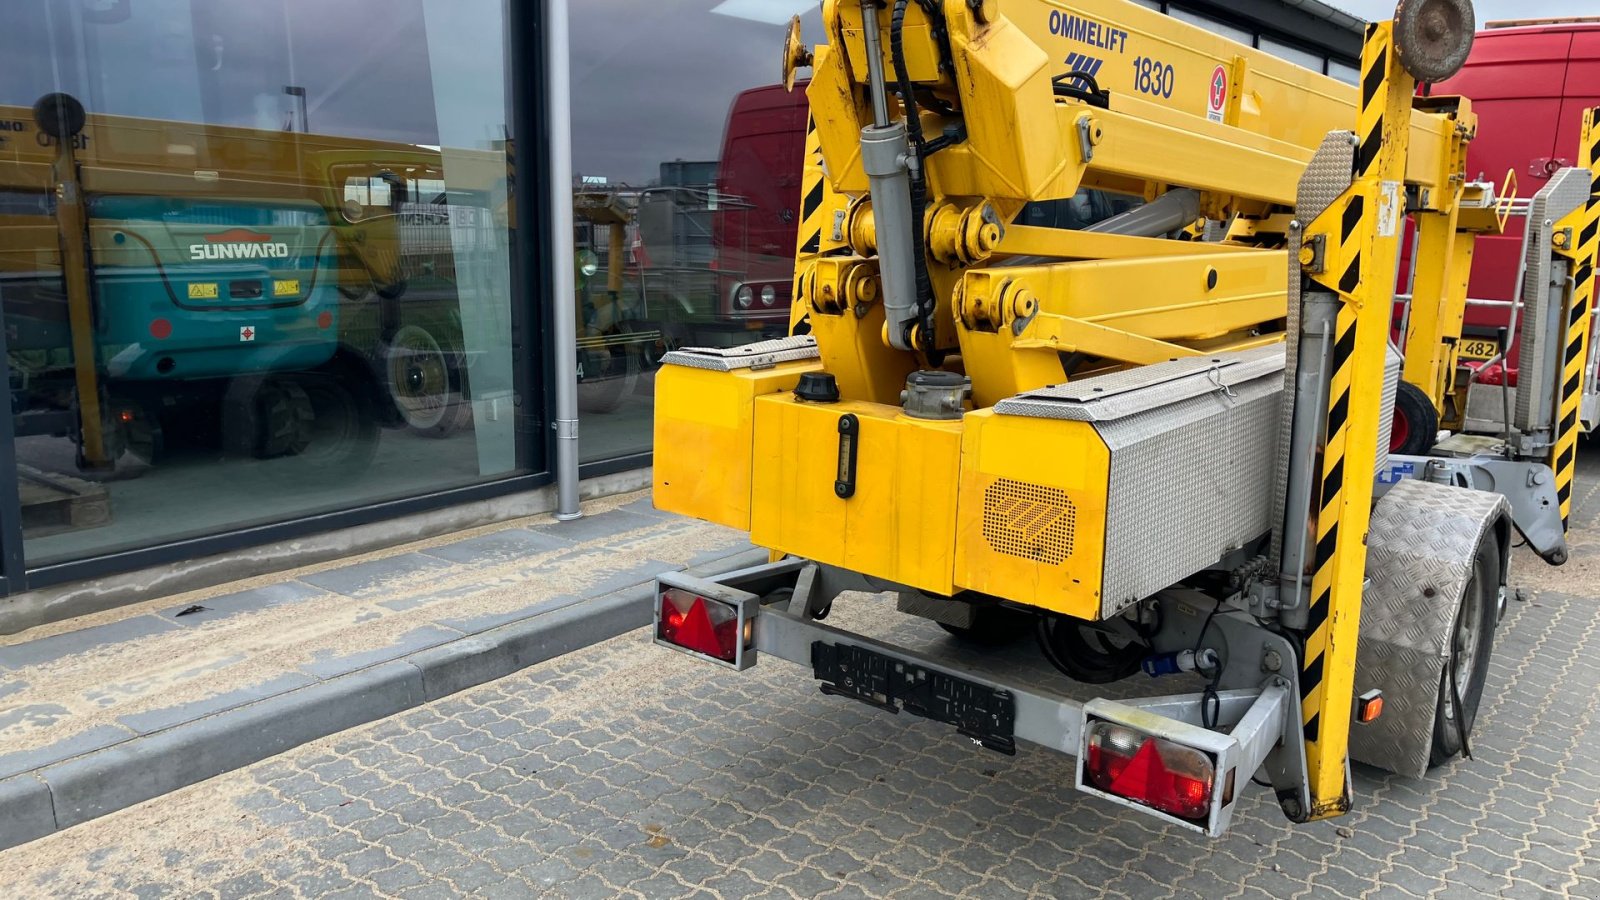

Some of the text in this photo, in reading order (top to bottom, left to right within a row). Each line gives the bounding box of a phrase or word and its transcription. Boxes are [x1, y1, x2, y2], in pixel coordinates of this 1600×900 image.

[1049, 9, 1128, 54] OMMELIFT
[1133, 55, 1175, 99] 1830
[189, 242, 289, 260] SUNWARD
[1466, 341, 1494, 356] 482
